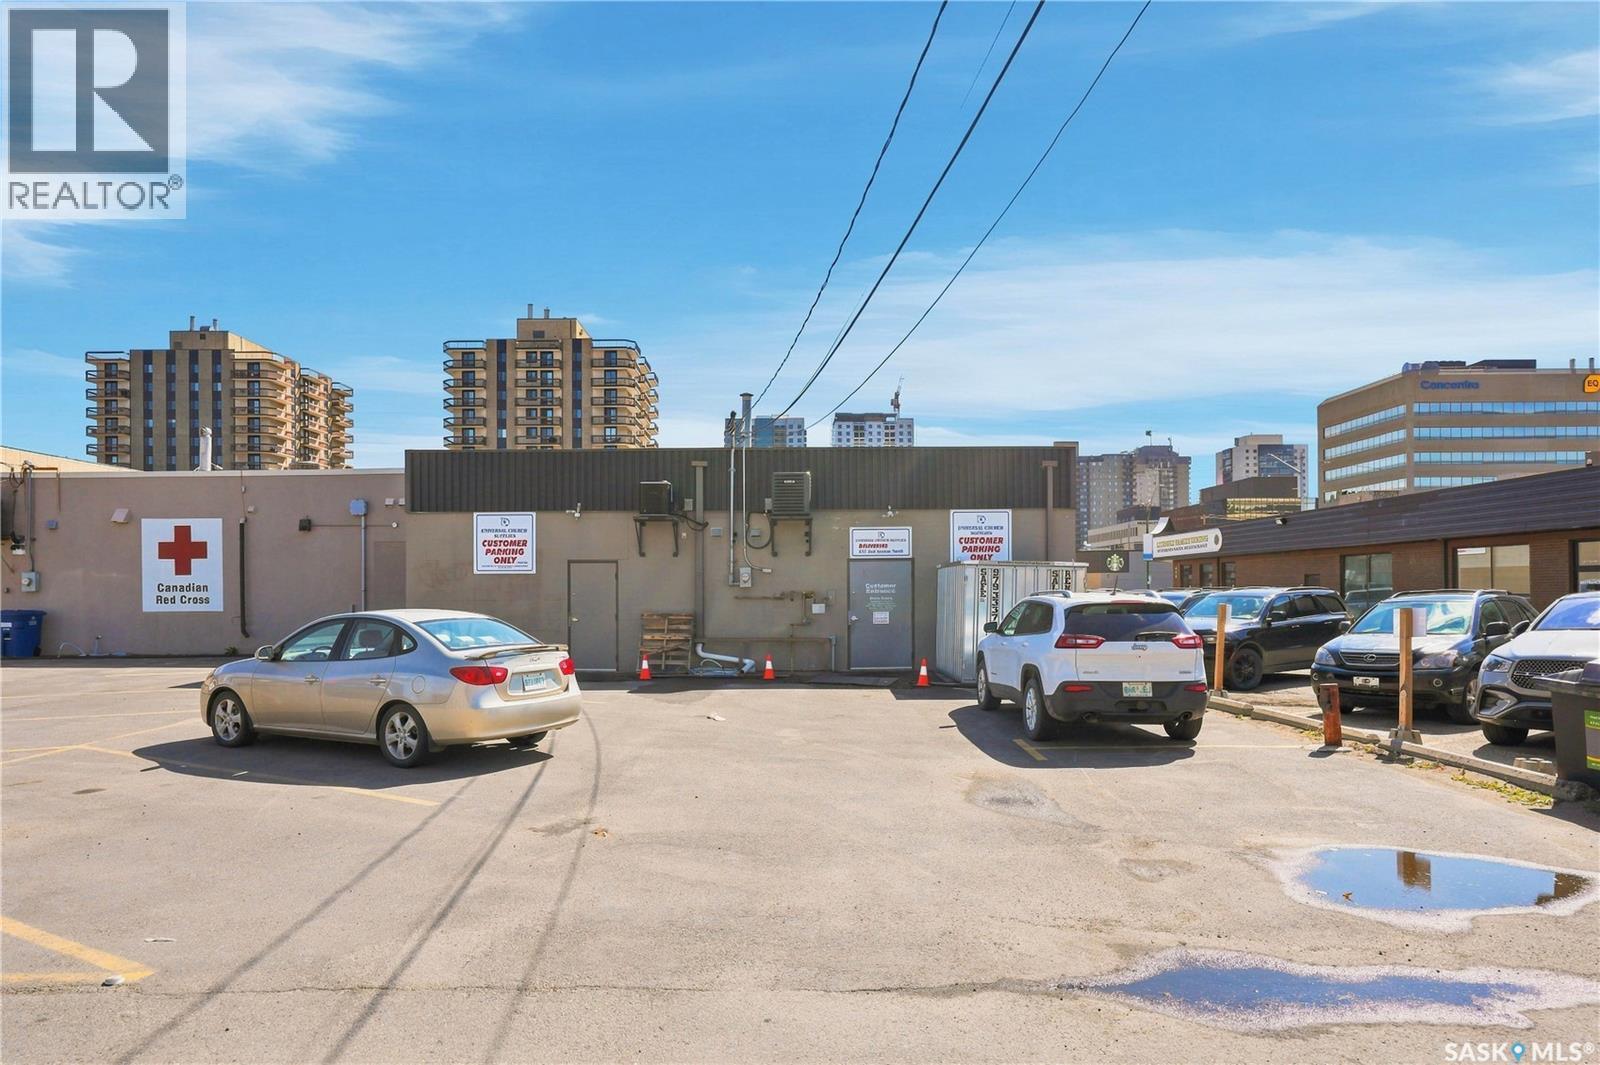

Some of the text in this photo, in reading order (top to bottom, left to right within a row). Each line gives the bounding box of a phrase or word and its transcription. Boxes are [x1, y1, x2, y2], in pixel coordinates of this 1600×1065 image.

[1420, 380, 1479, 390] Concentra
[1587, 379, 1599, 387] EQ
[958, 537, 1004, 545] CUSTOMER
[157, 583, 209, 593] Canadian
[155, 595, 211, 605] Red Cross
